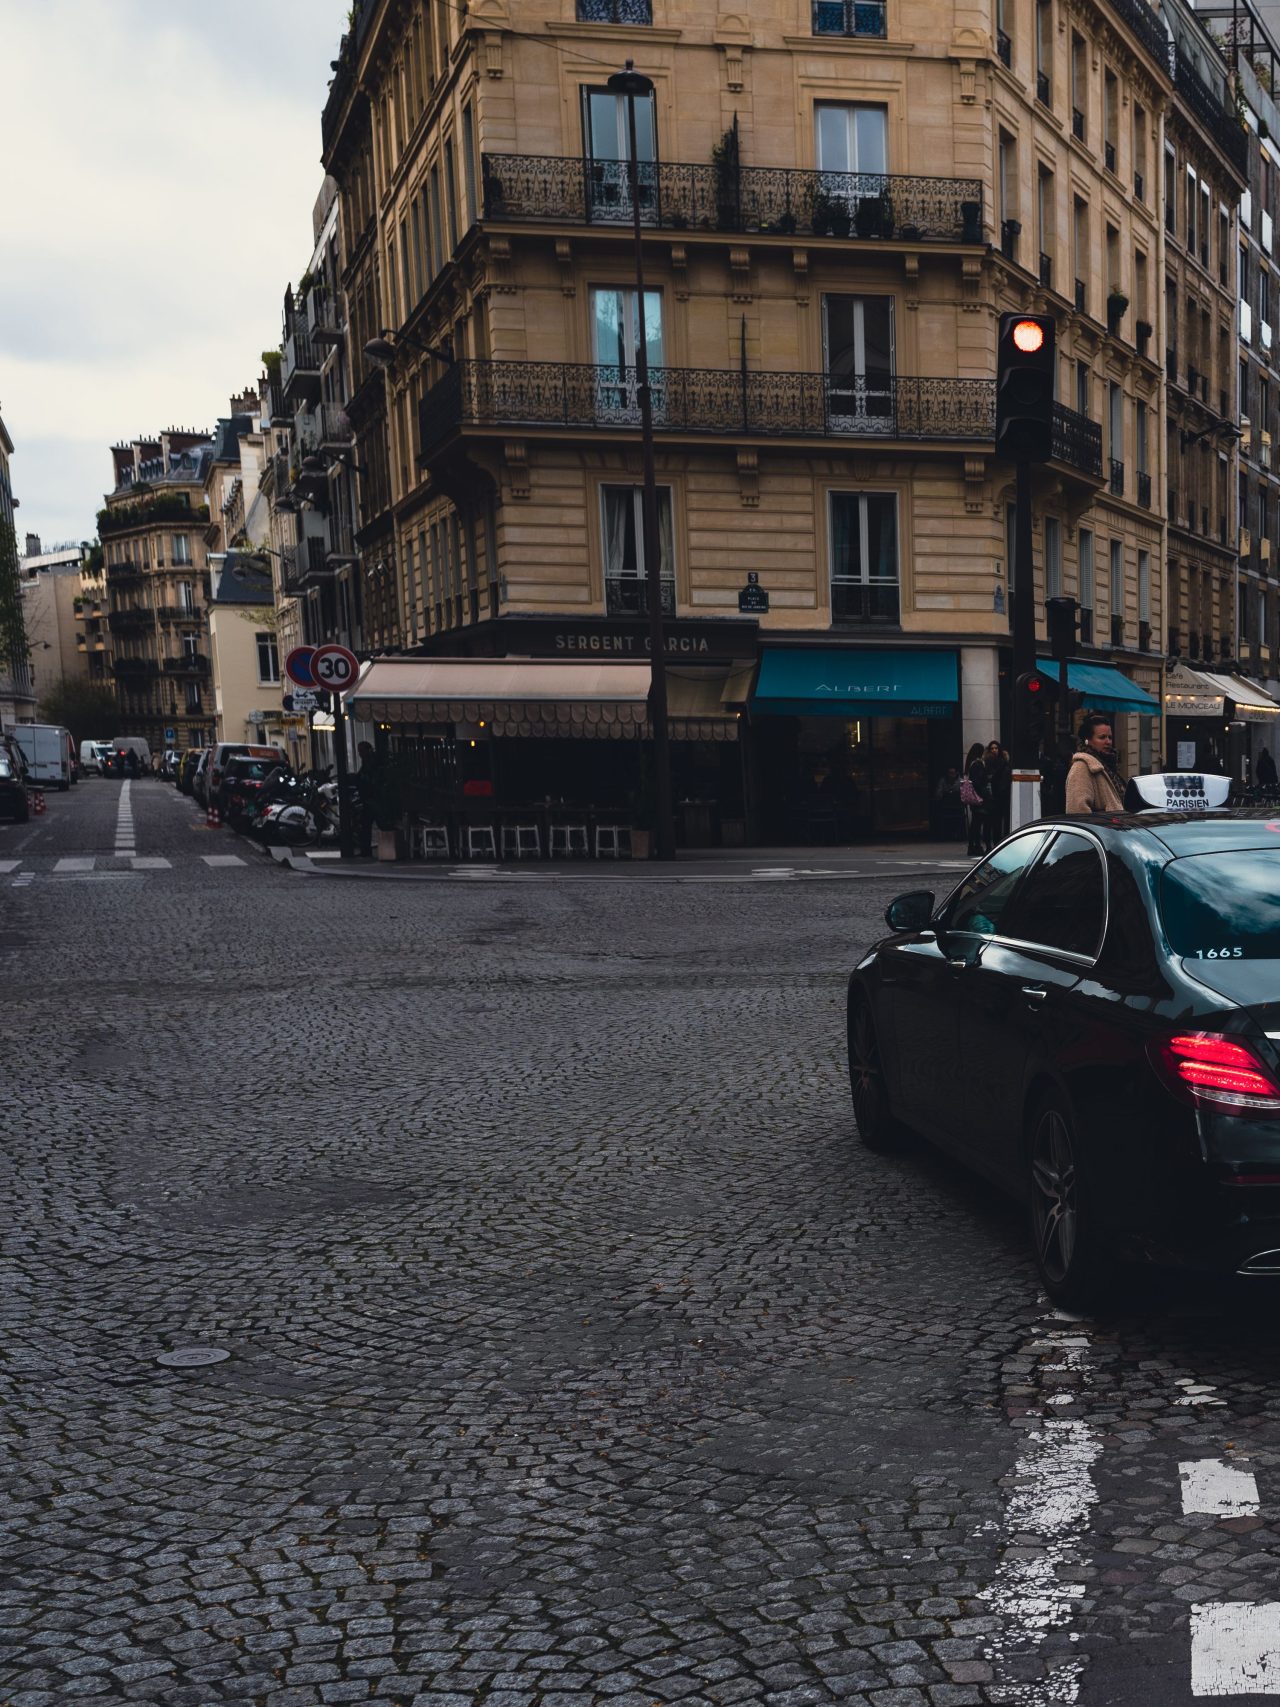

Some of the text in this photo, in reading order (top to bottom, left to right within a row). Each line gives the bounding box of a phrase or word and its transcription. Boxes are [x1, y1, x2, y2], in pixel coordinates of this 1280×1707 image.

[750, 573, 756, 582] 3
[555, 635, 709, 652] SERGENT GRCIA
[320, 657, 349, 679] 30
[815, 683, 904, 692] ALBERT
[1166, 681, 1210, 690] Restaurant
[911, 703, 948, 716] ALBERT
[1166, 701, 1220, 710] LE MONCEAU
[1166, 799, 1210, 808] PARISIEN
[1196, 947, 1243, 960] 1665
